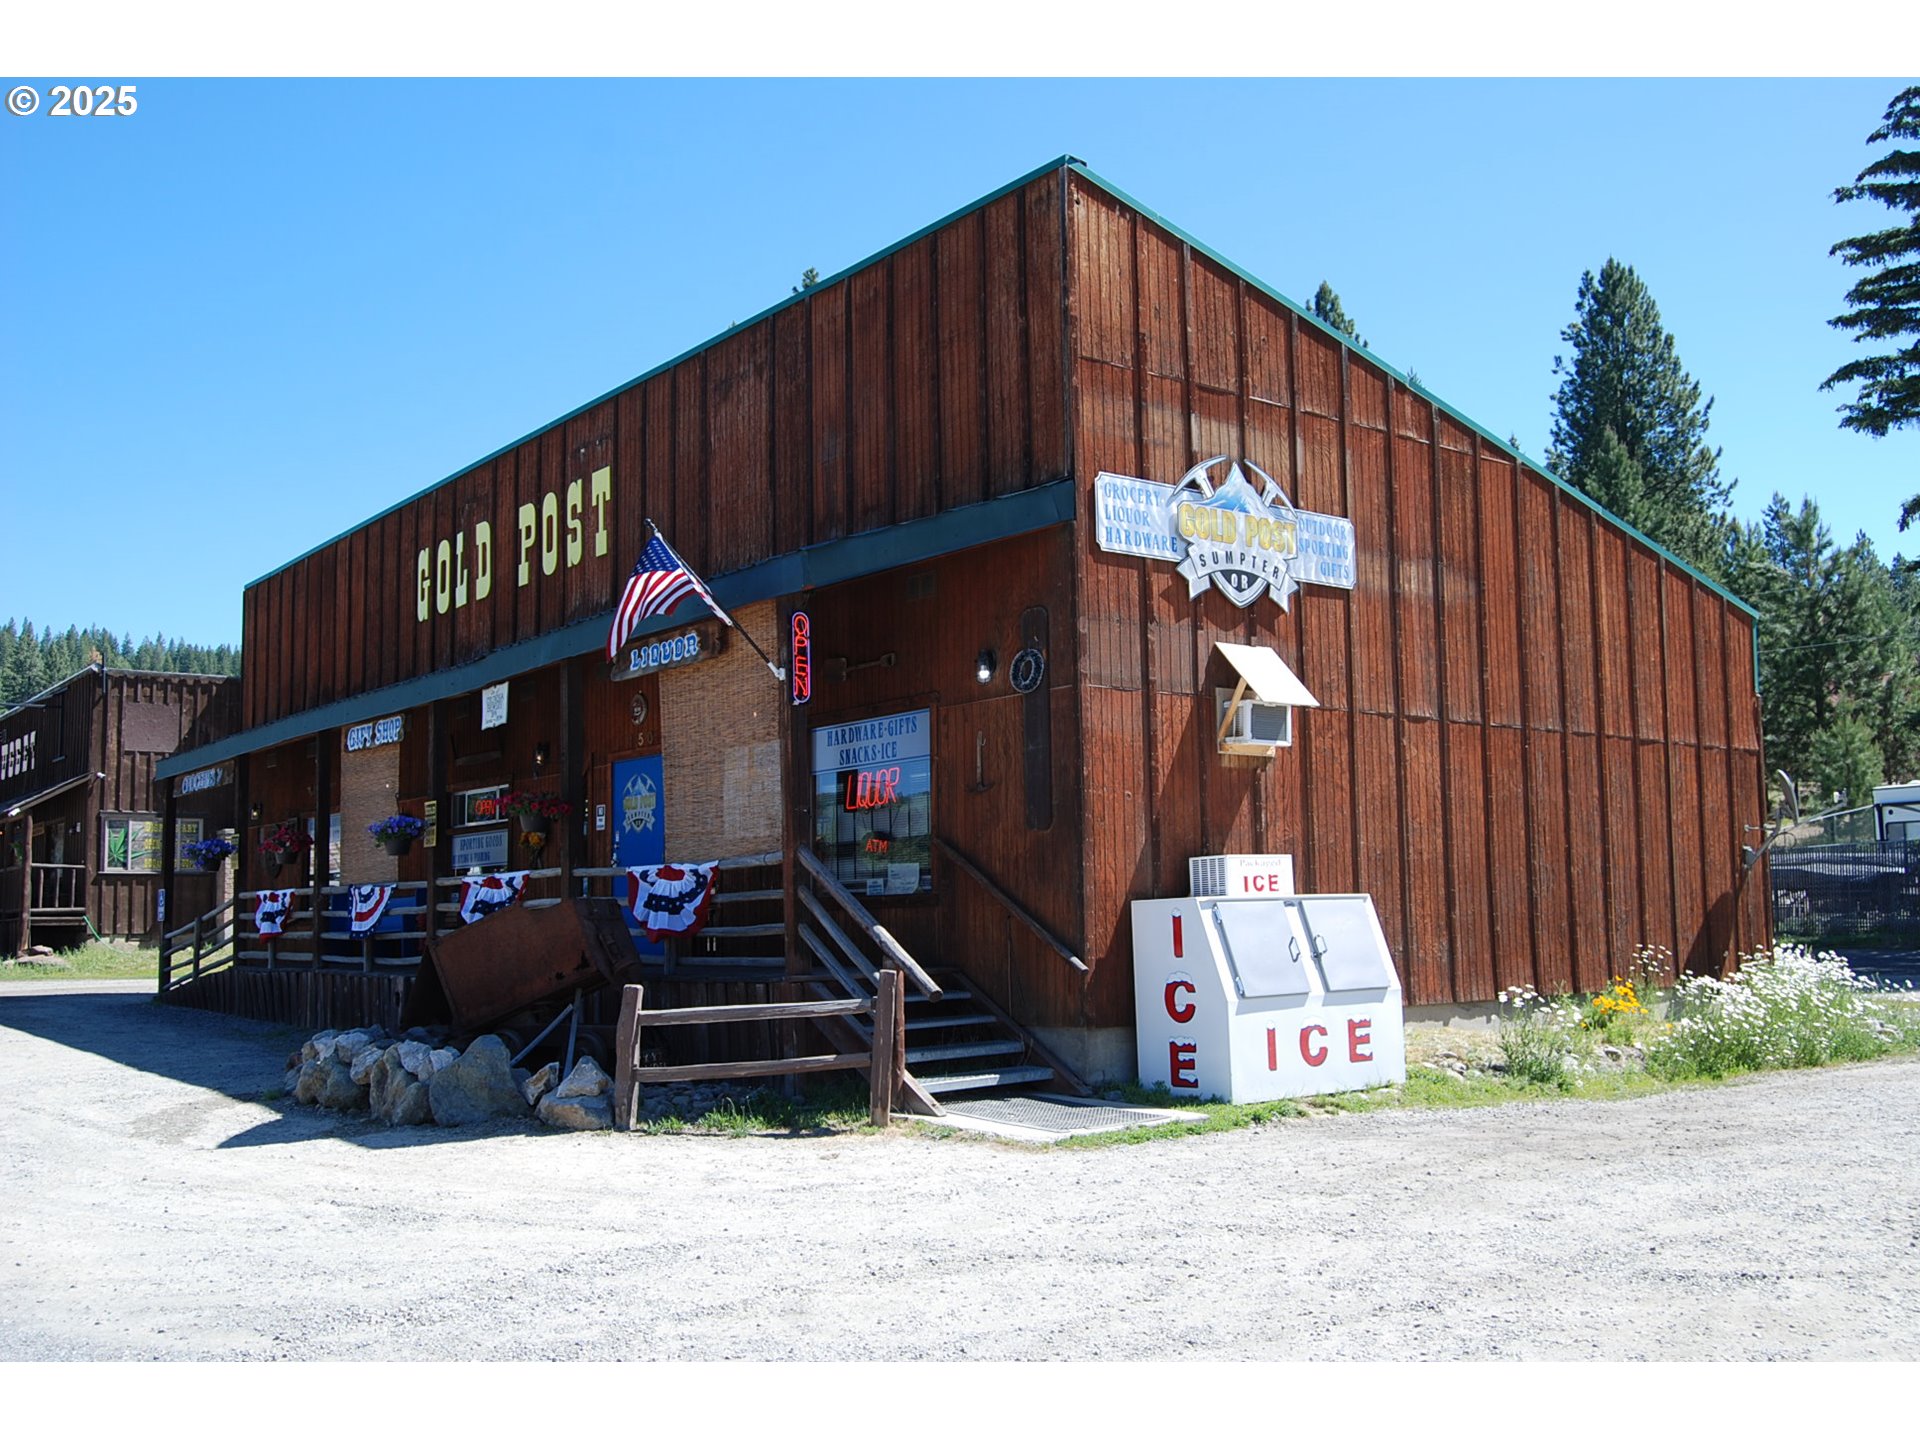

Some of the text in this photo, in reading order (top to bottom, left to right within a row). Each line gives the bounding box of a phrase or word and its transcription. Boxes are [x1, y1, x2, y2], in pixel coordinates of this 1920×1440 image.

[1104, 481, 1161, 508] GROCERY
[1104, 504, 1150, 526] LIQUOR
[1178, 502, 1296, 554] GOLD POST
[1299, 518, 1347, 539] OUTDOOR
[417, 465, 611, 623] GOLD POST
[1105, 525, 1178, 553] HARDWARE
[1299, 536, 1349, 560] SPORTING
[1199, 550, 1280, 579] SUMPTER
[1320, 562, 1349, 579] GIFTS
[1230, 573, 1249, 590] OR
[630, 632, 700, 671] LIQUOR
[794, 614, 809, 698] OPEN
[347, 716, 402, 751] GIFT SHOP
[846, 767, 900, 811] LIQUOR
[865, 838, 888, 853] ATM
[1240, 859, 1281, 868] Packaged
[1243, 874, 1280, 892] ICE
[1164, 907, 1199, 1088] ICE
[1266, 1014, 1374, 1072] ICE
